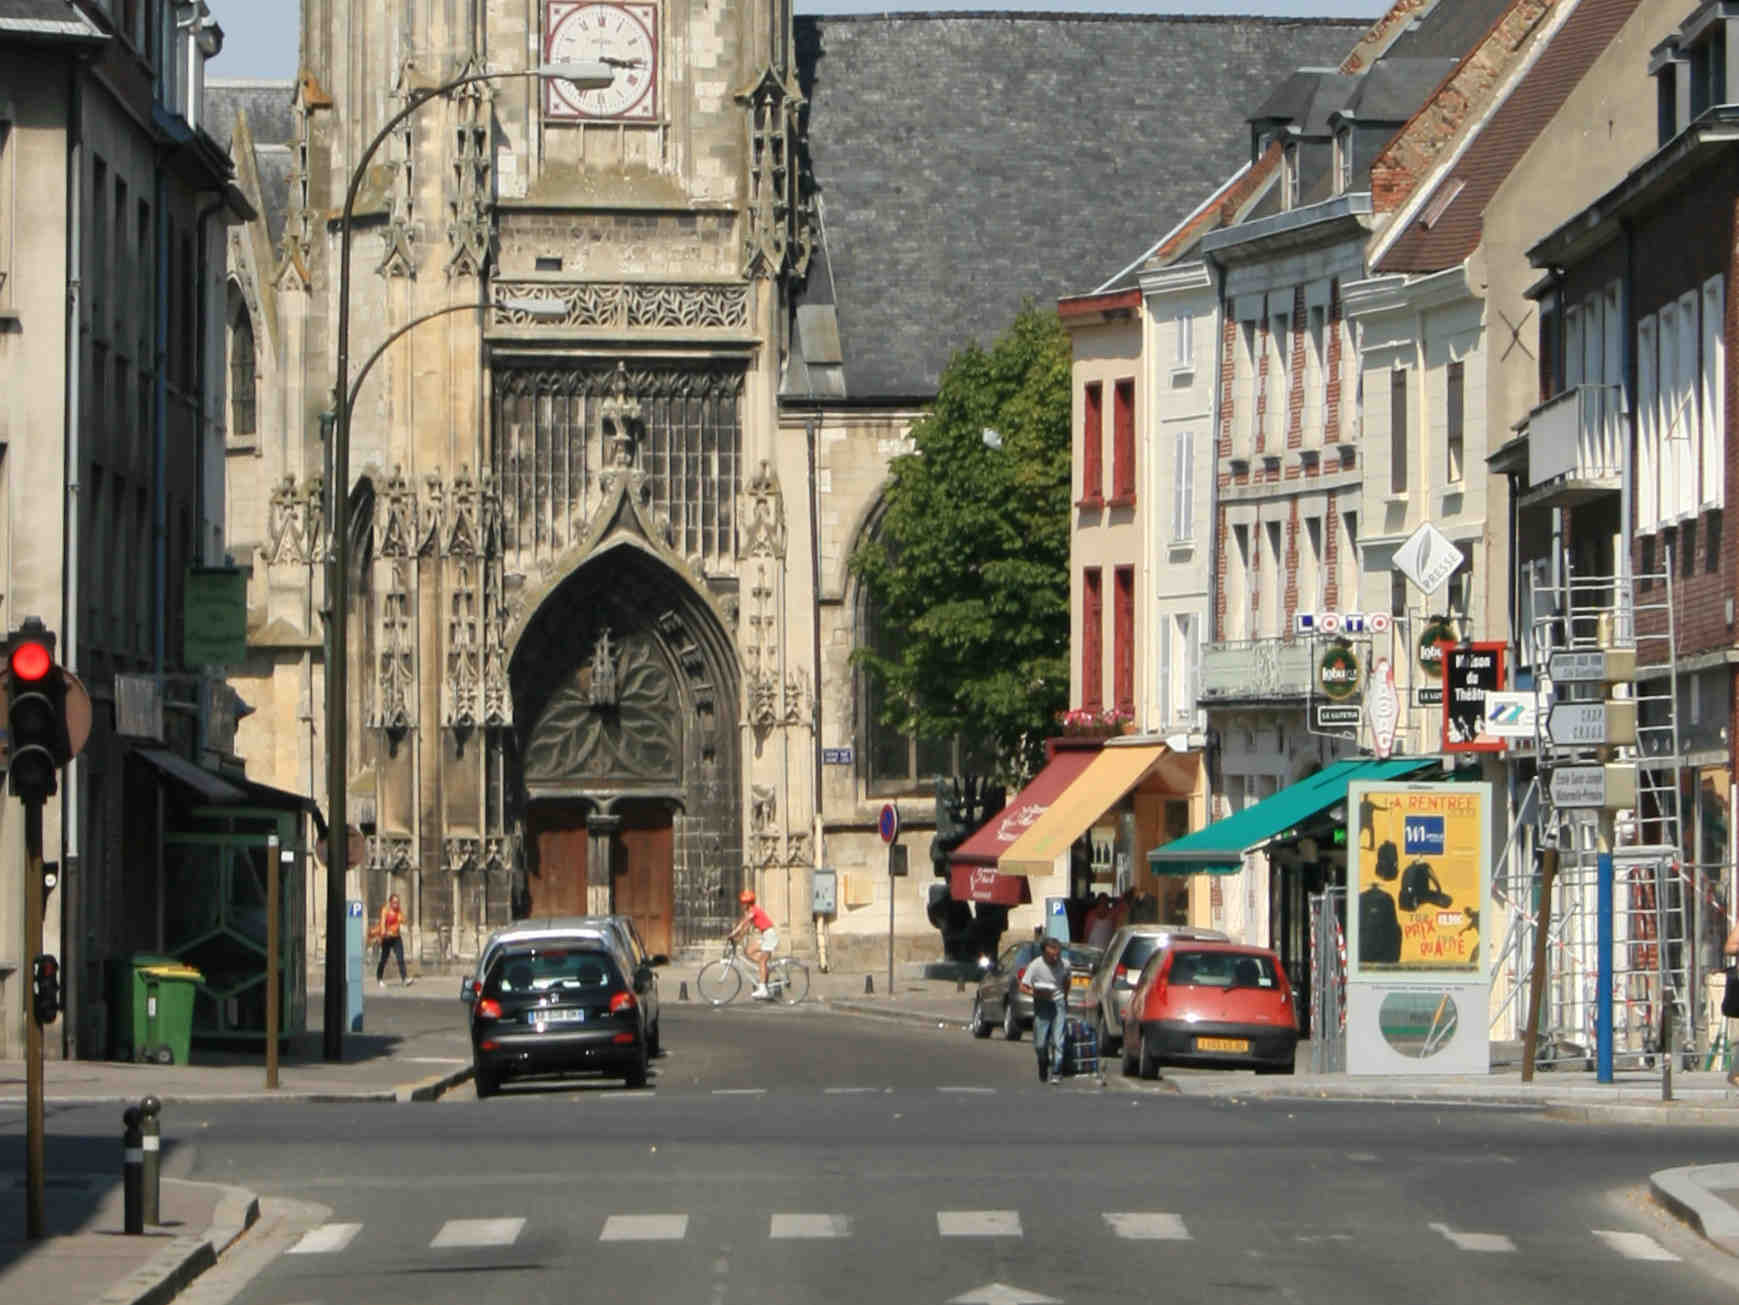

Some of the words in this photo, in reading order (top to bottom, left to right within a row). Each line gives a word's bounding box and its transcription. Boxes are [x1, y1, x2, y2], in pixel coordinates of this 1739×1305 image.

[1422, 550, 1458, 590] PRESSE
[1297, 615, 1390, 633] LOTO
[1466, 672, 1479, 684] du
[1455, 686, 1485, 701] Théâtr
